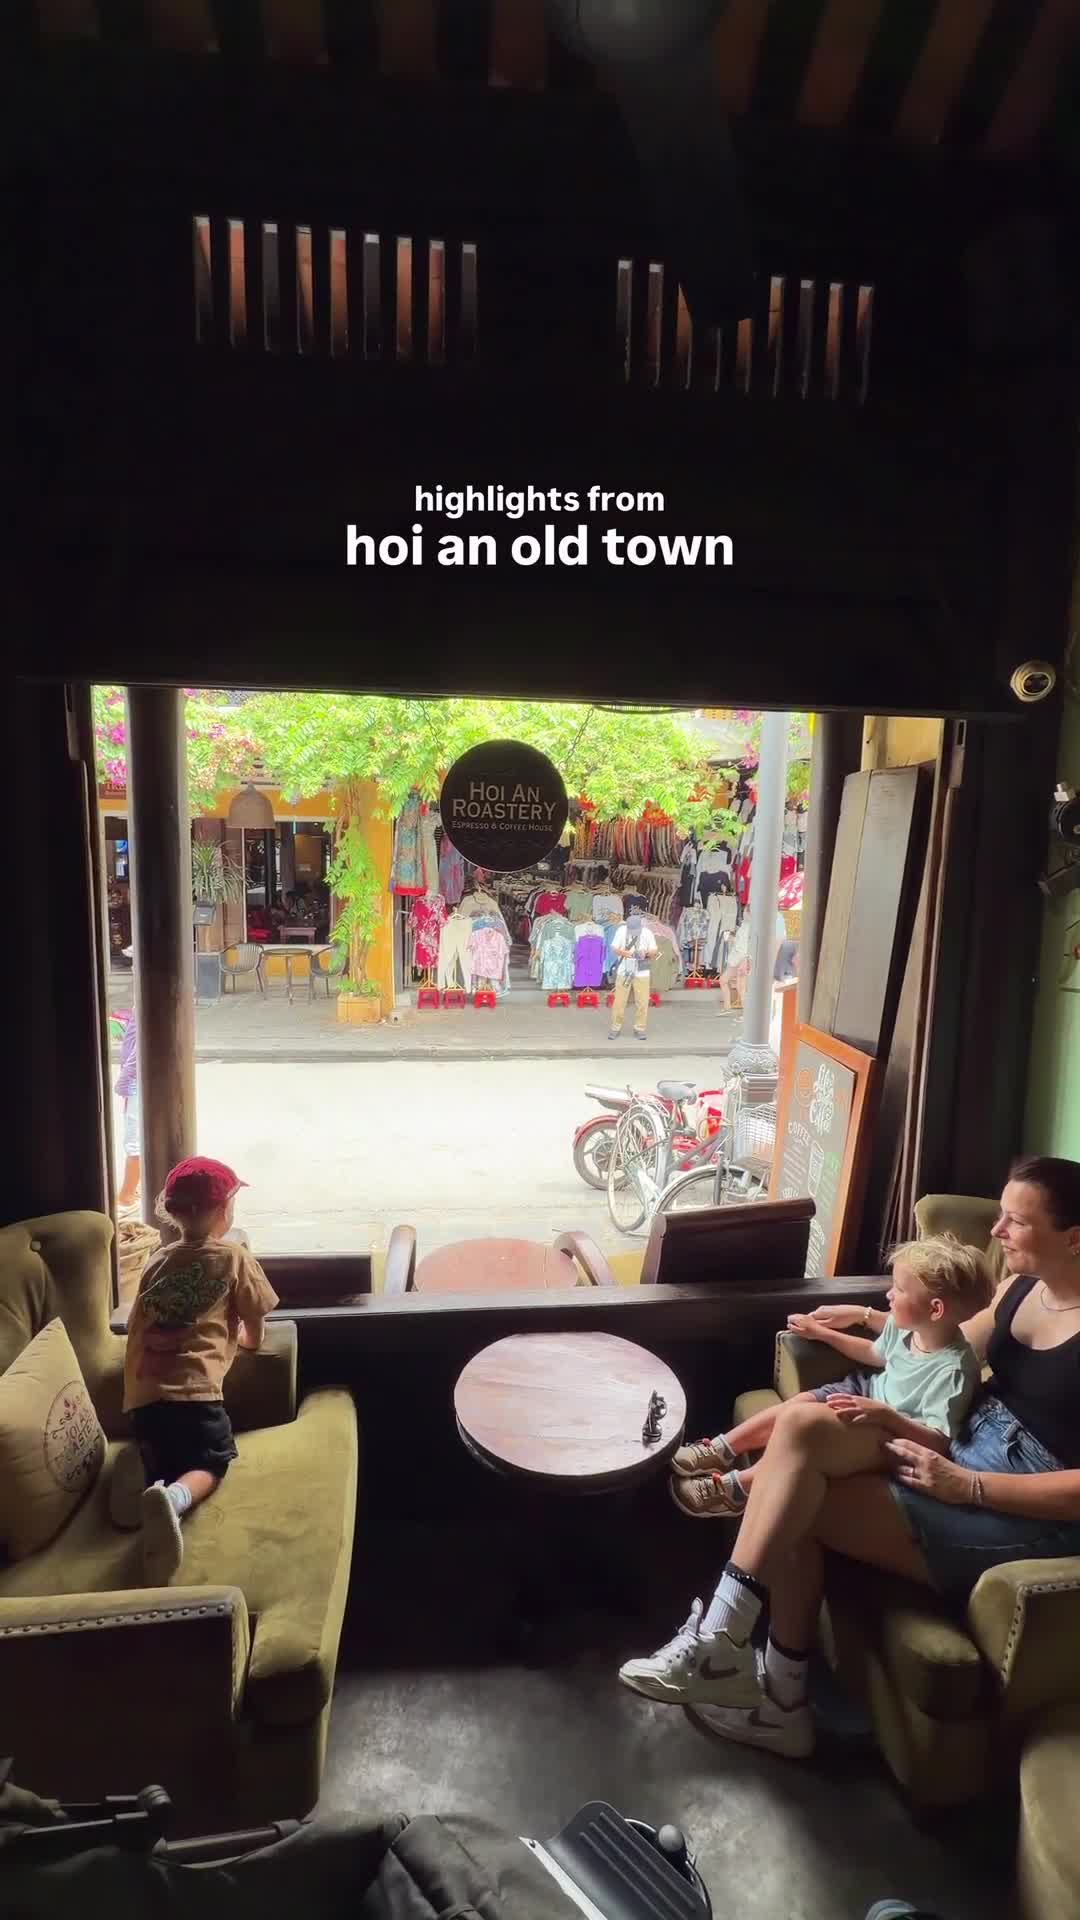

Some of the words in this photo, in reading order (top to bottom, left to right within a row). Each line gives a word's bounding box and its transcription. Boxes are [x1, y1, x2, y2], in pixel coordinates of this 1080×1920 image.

[470, 782, 505, 801] HOI
[513, 784, 540, 803] AN
[452, 799, 557, 821] ROASTERY
[452, 821, 489, 830] ESPRESSO
[499, 822, 527, 831] COFFEE
[528, 823, 553, 832] HOUSE
